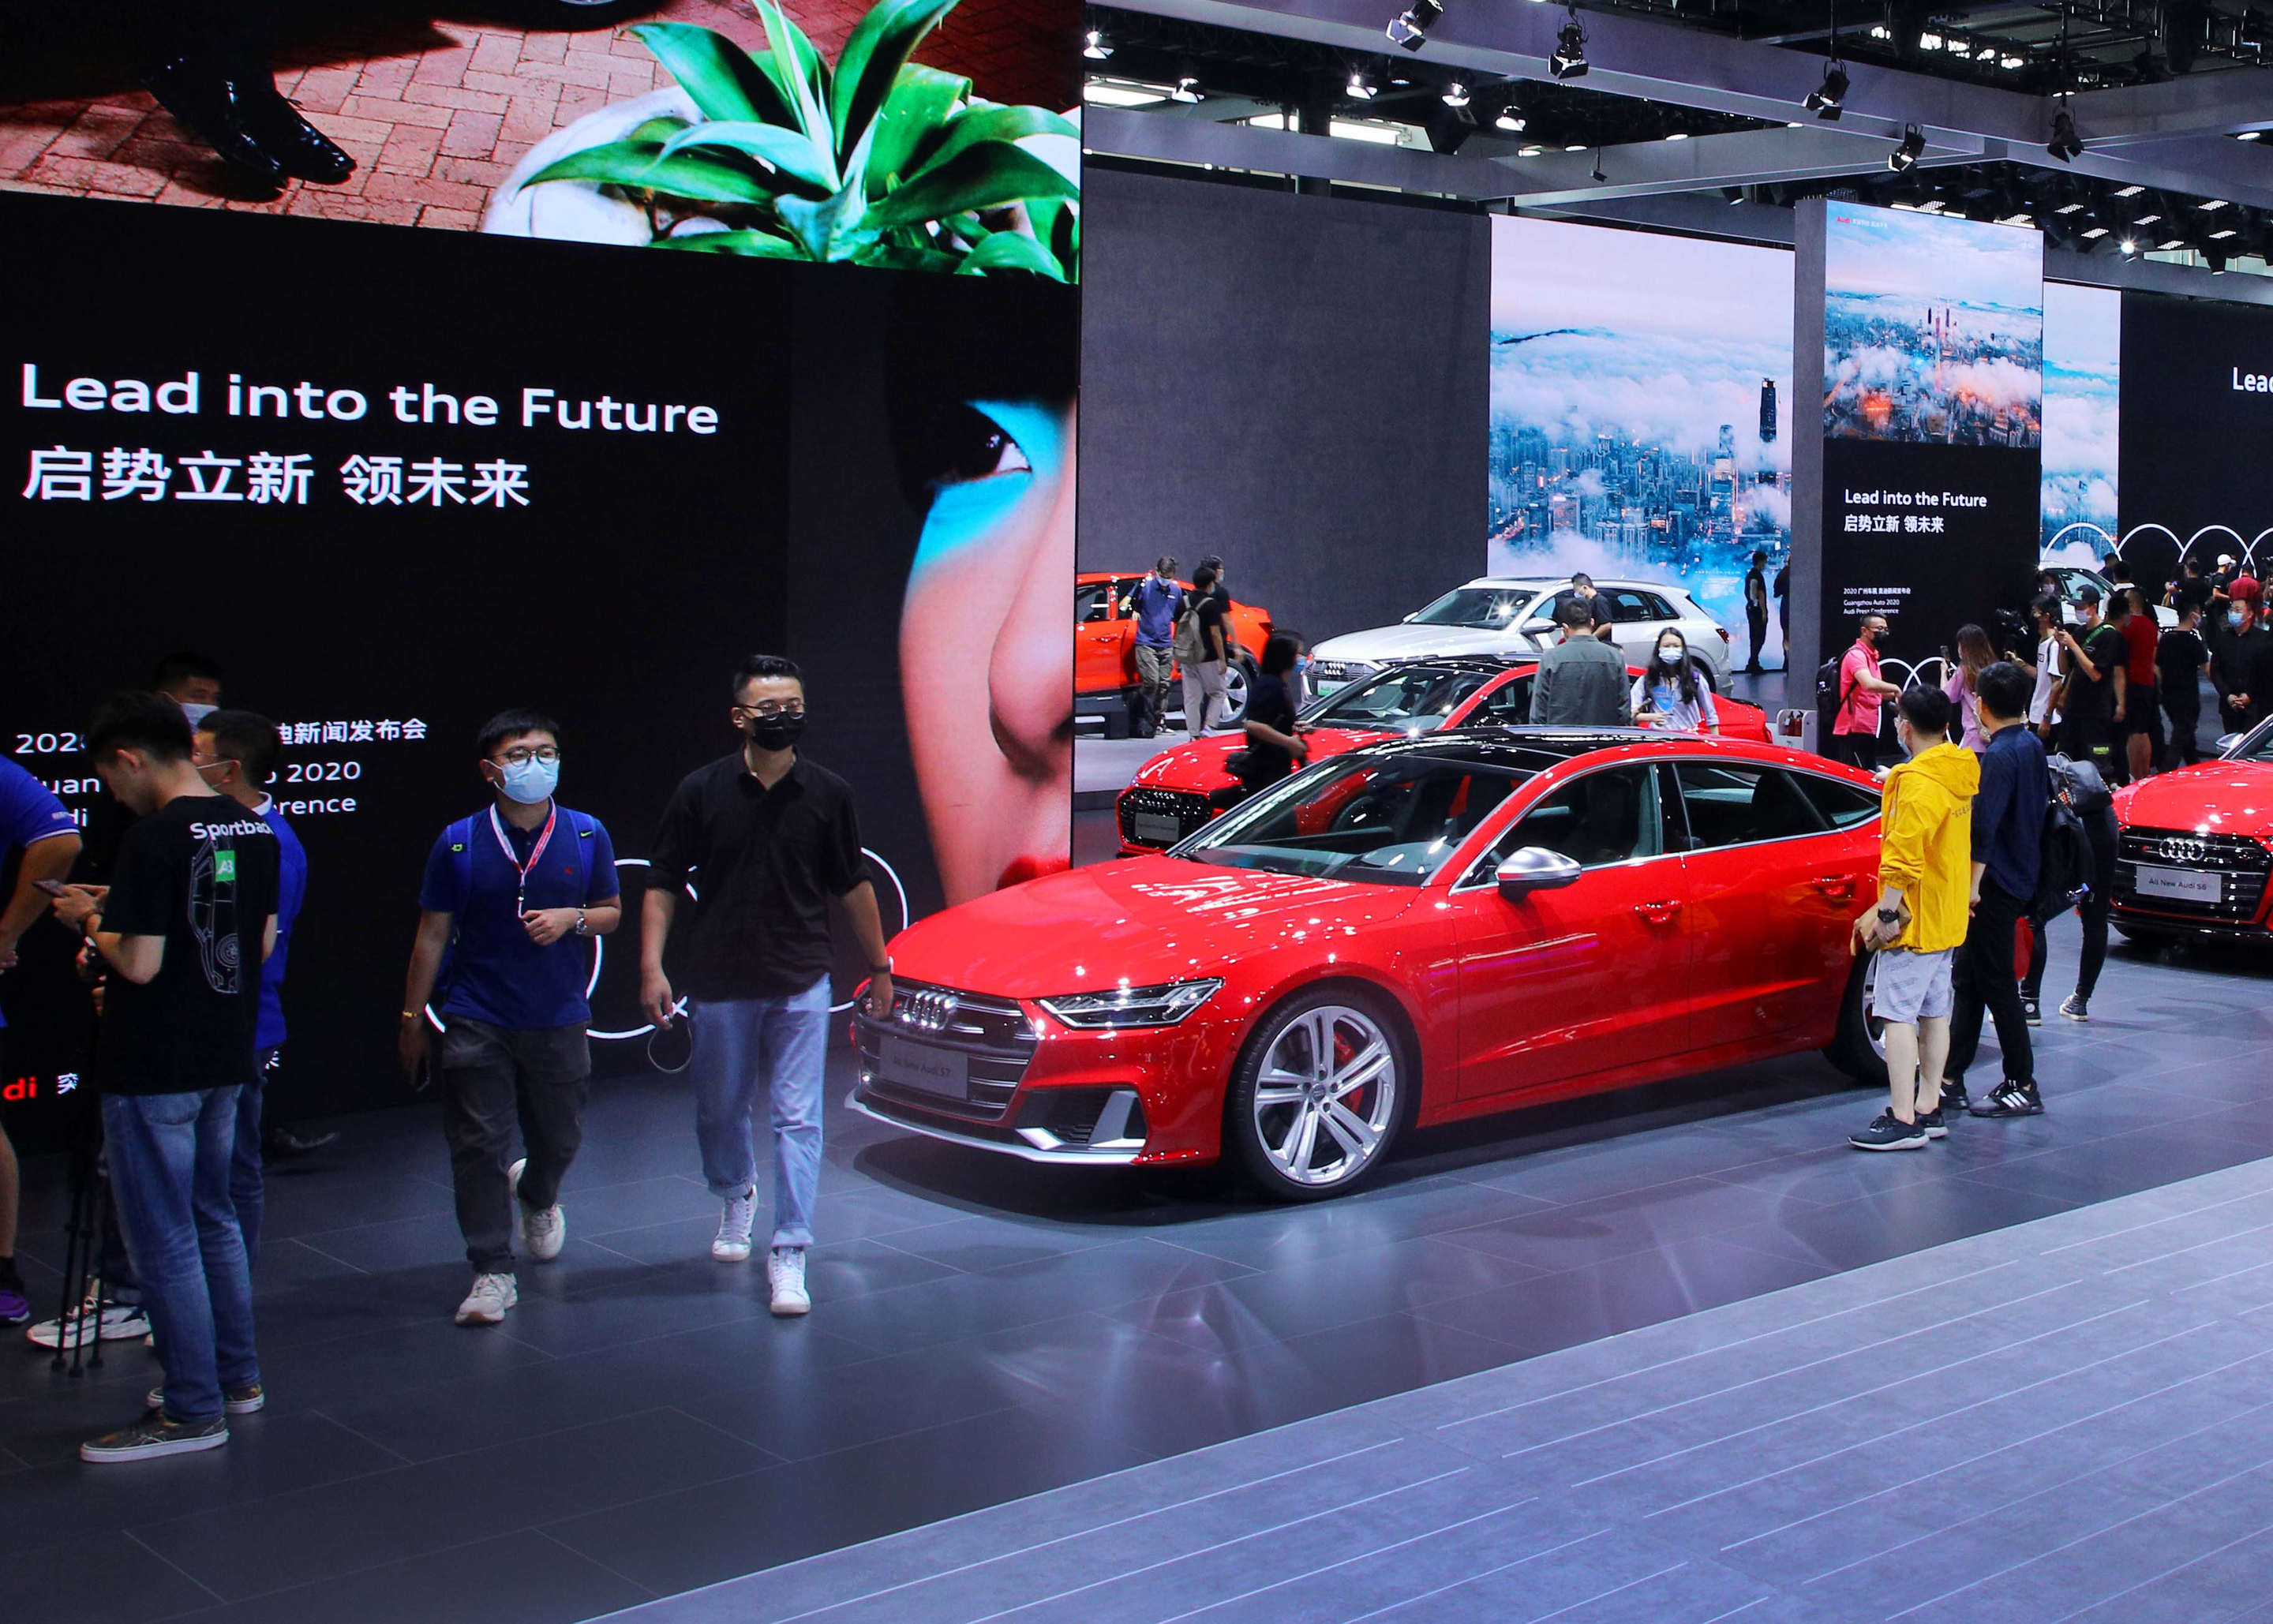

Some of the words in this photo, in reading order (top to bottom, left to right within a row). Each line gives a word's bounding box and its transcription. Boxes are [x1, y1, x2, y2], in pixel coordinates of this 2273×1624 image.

[22, 363, 199, 414] Lead
[229, 373, 367, 421] into
[388, 383, 499, 426] the
[522, 387, 719, 435] Future
[22, 444, 314, 505] 启势立新
[339, 454, 530, 508] 领未来
[1844, 488, 1879, 505] Lead
[1882, 490, 1912, 506] into
[1915, 491, 1939, 507] the
[1942, 492, 1988, 507] Future
[1844, 514, 1900, 533] 启势立新
[1903, 515, 1945, 533] 领未来
[1843, 599, 1873, 608] Guangzhou
[286, 761, 361, 783] 2020
[274, 797, 357, 815] rence
[218, 859, 234, 874] A3
